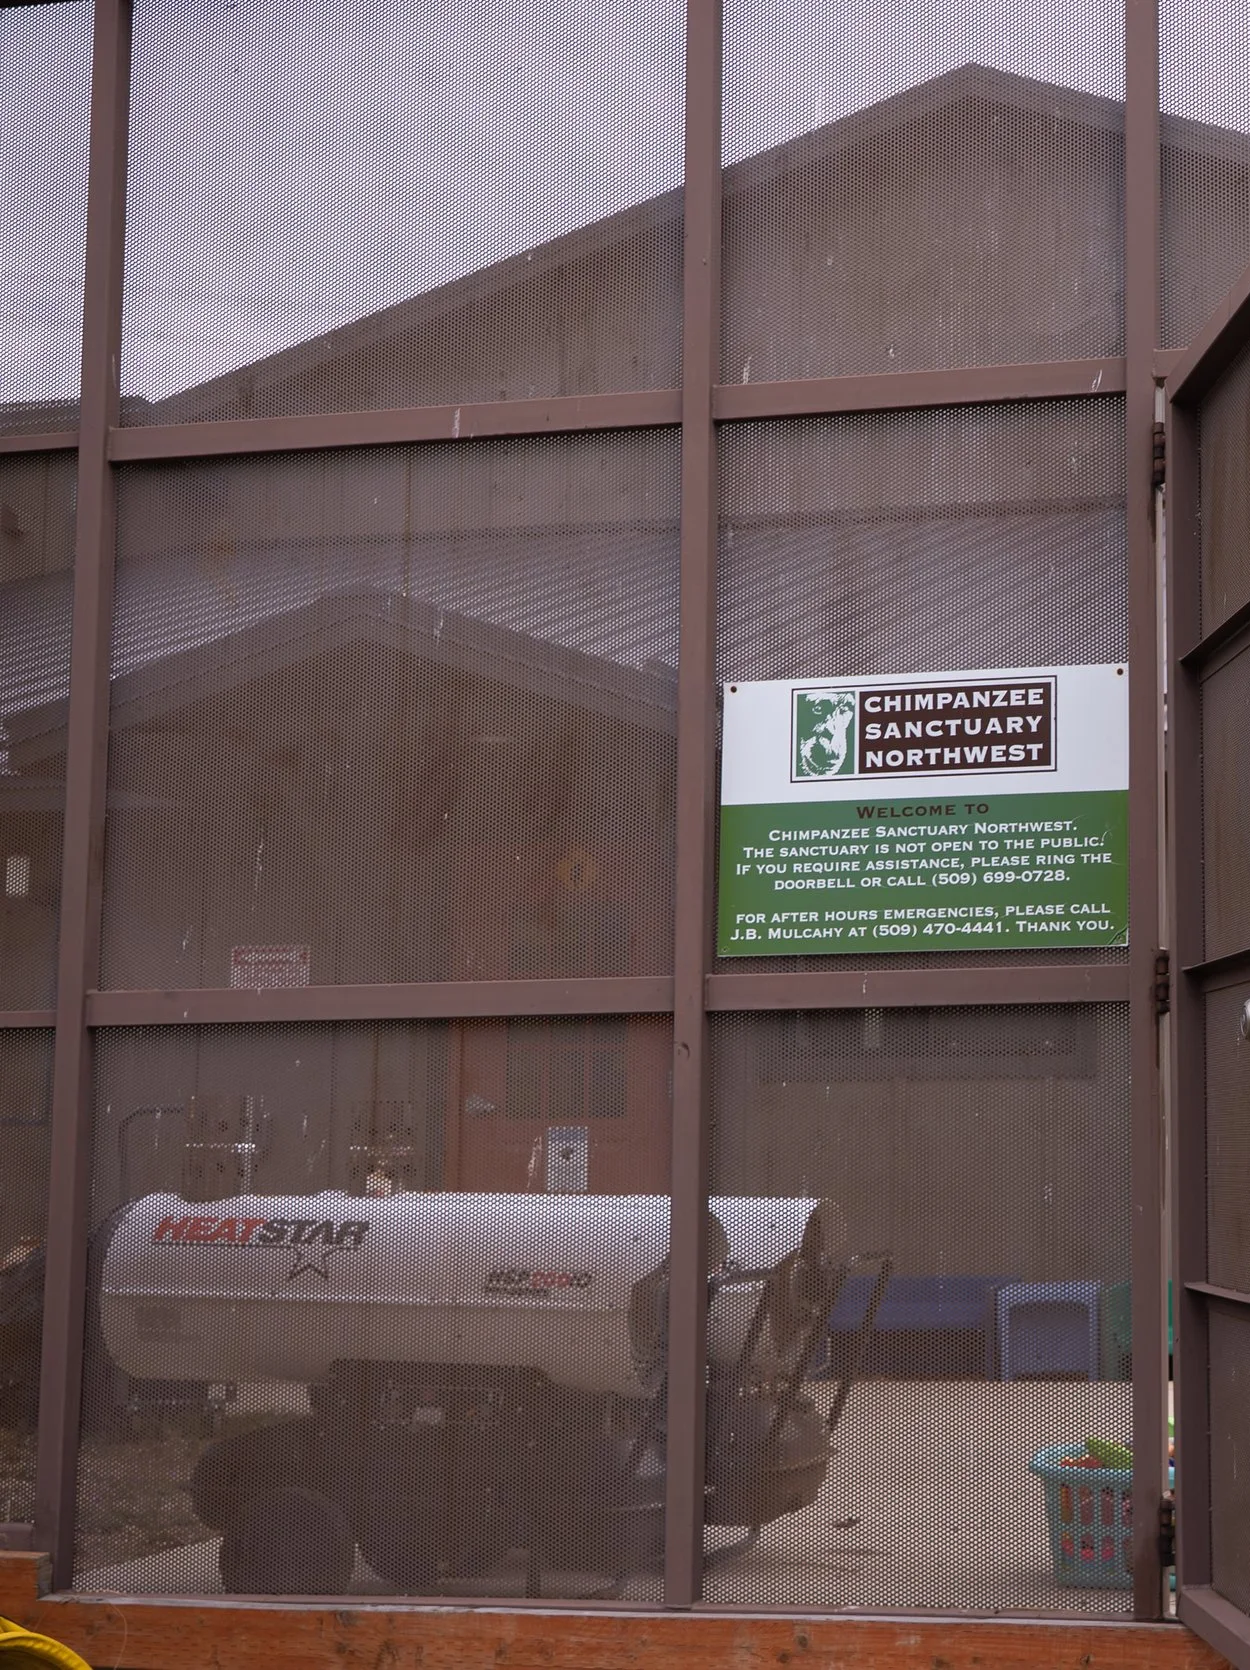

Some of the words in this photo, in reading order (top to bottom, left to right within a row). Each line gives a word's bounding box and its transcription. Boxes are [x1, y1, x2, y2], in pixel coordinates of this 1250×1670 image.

[864, 688, 1044, 713] CHIMPANZEE
[865, 716, 1043, 740] SANCTUARY
[866, 743, 1044, 768] NORTHWEST
[857, 804, 956, 819] WELCOME
[965, 803, 989, 815] TO
[769, 827, 870, 842] CHIMPANZEE
[876, 823, 968, 838] SANCTUARY
[974, 820, 1077, 835] NORTHWEST.
[743, 846, 774, 859] THE
[780, 844, 869, 858] SANCTUARY
[875, 843, 889, 855] IS
[896, 841, 926, 854] NOT
[931, 840, 973, 853] OPEN
[979, 839, 999, 851] TO
[1004, 838, 1034, 850] THE
[1041, 836, 1104, 849] PUBLIC.
[736, 863, 751, 876] IF
[756, 863, 787, 875] YOU
[793, 860, 860, 874] REQUIRE
[865, 857, 964, 872] ASSISTANCE,
[971, 854, 1030, 868] PLEASE
[1036, 853, 1075, 866] RING
[1081, 852, 1112, 864] THE
[774, 877, 855, 891] DOORBELL
[860, 876, 881, 888] OR
[887, 875, 926, 887] CALL
[932, 871, 977, 888] (509)
[983, 868, 1070, 884] 699-0728.
[736, 912, 766, 925] FOR
[771, 911, 819, 924] AFTER
[825, 909, 878, 922] HOURS
[884, 905, 998, 920] EMERGENCIES,
[1006, 903, 1064, 917] PLEASE
[1070, 902, 1110, 915] CALL
[730, 927, 762, 941] J.B.
[768, 926, 843, 940] MULCAHY
[848, 926, 867, 938] AT
[873, 923, 917, 939] (509)
[923, 920, 1009, 936] 470-4441.
[1016, 920, 1071, 933] THANK
[1076, 919, 1114, 931] YOU.
[153, 1215, 370, 1245] HEATSTAR
